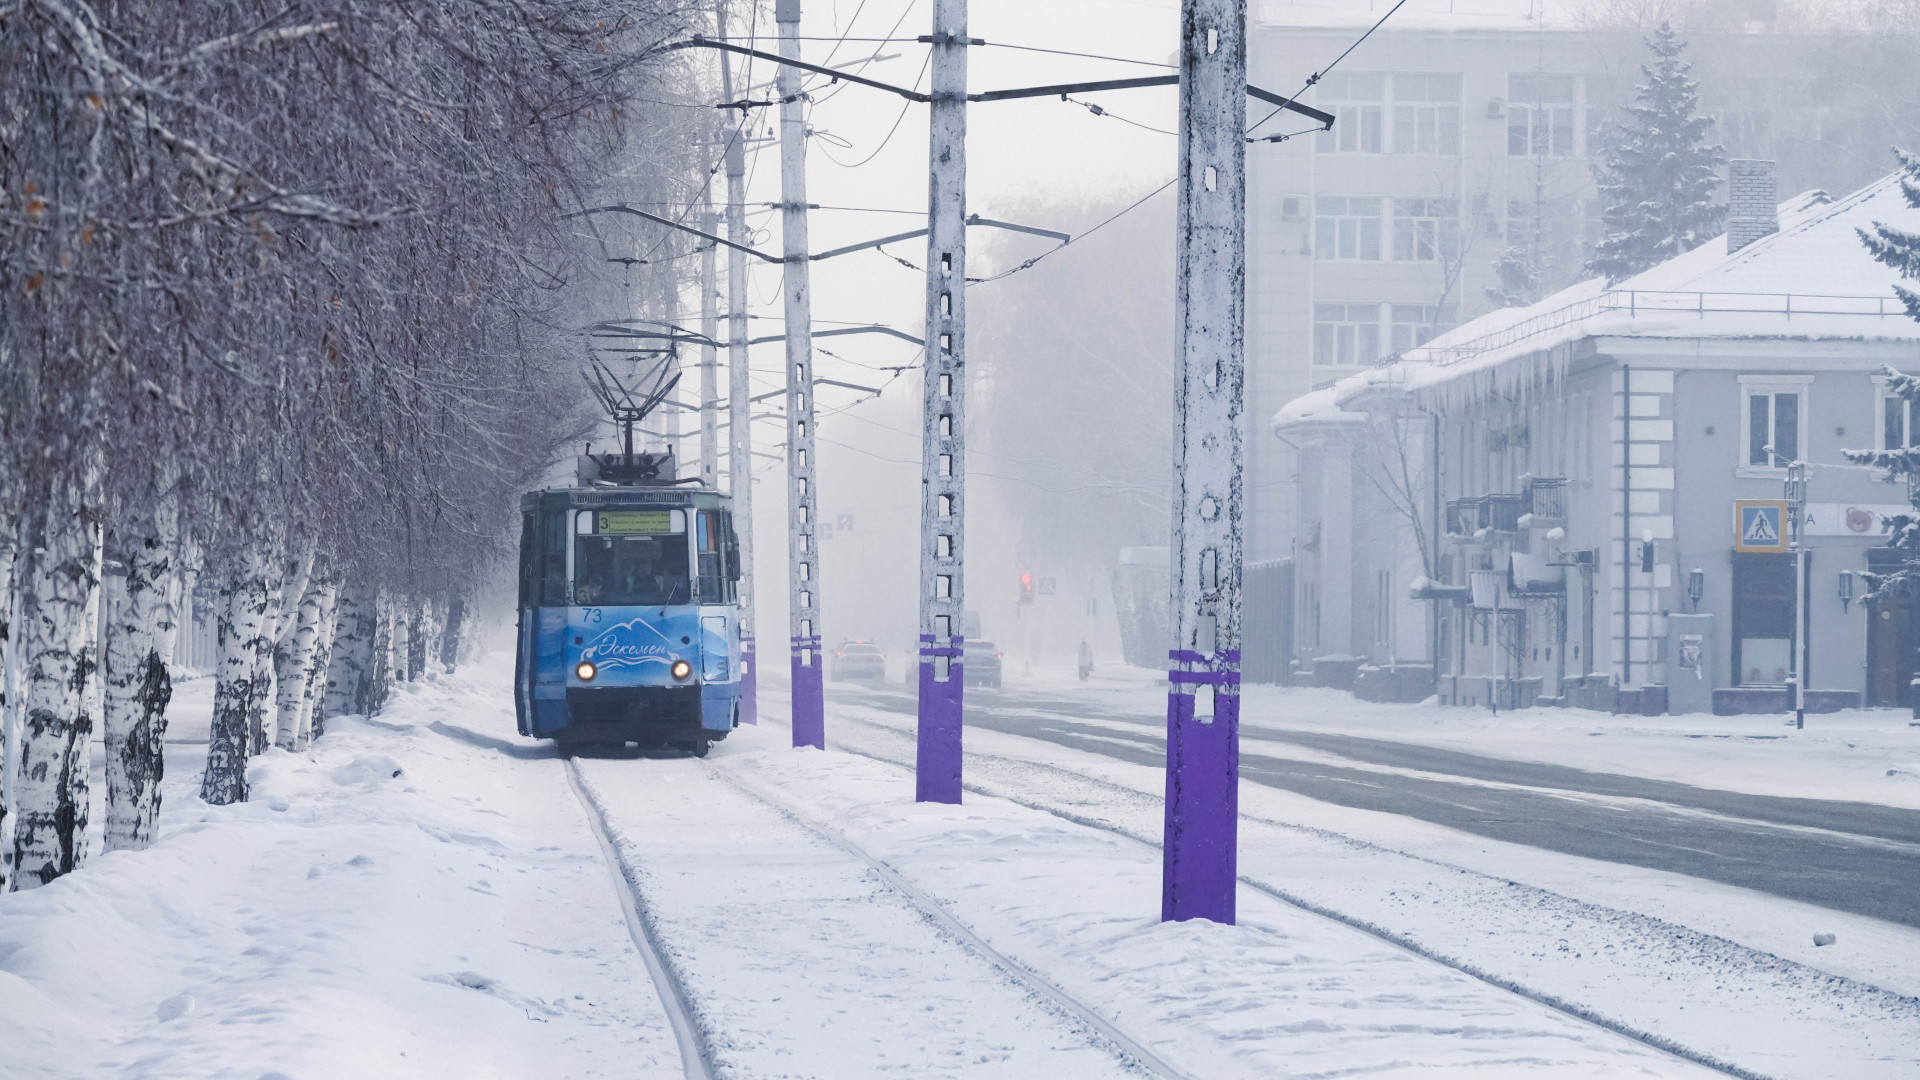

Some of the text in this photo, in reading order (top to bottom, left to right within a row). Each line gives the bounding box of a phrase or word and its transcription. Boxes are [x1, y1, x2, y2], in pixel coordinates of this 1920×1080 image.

[600, 517, 609, 530] 3
[582, 608, 602, 622] 73
[598, 634, 666, 656] Өскемен
